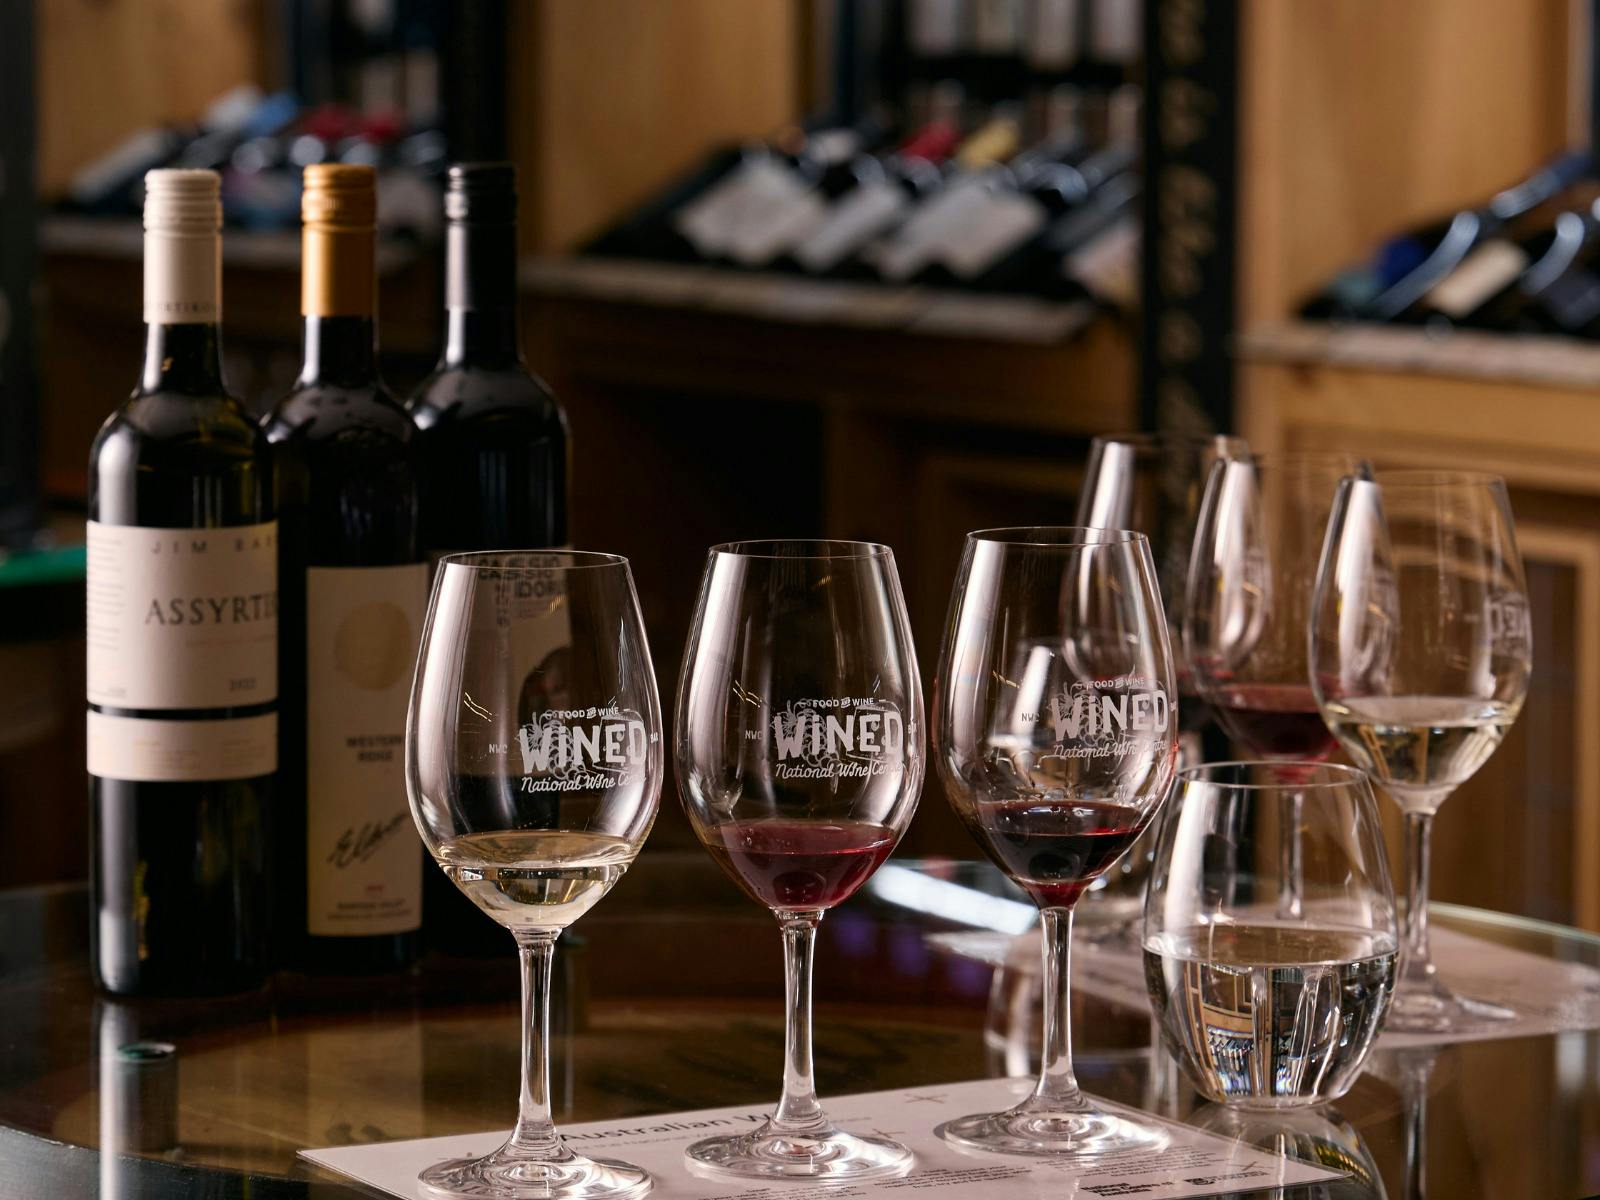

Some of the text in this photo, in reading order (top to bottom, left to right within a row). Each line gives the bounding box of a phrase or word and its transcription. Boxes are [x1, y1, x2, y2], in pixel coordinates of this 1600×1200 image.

[152, 541, 207, 554] JIM
[1091, 680, 1113, 690] FOOD
[812, 699, 840, 708] FOOD
[851, 697, 874, 707] WINE
[559, 710, 585, 719] FOOD
[598, 706, 619, 718] WINE
[745, 730, 763, 740] NWC
[488, 743, 508, 754] NWC
[776, 763, 836, 779] National
[521, 776, 586, 794] National
[559, 1117, 732, 1142] Australian
